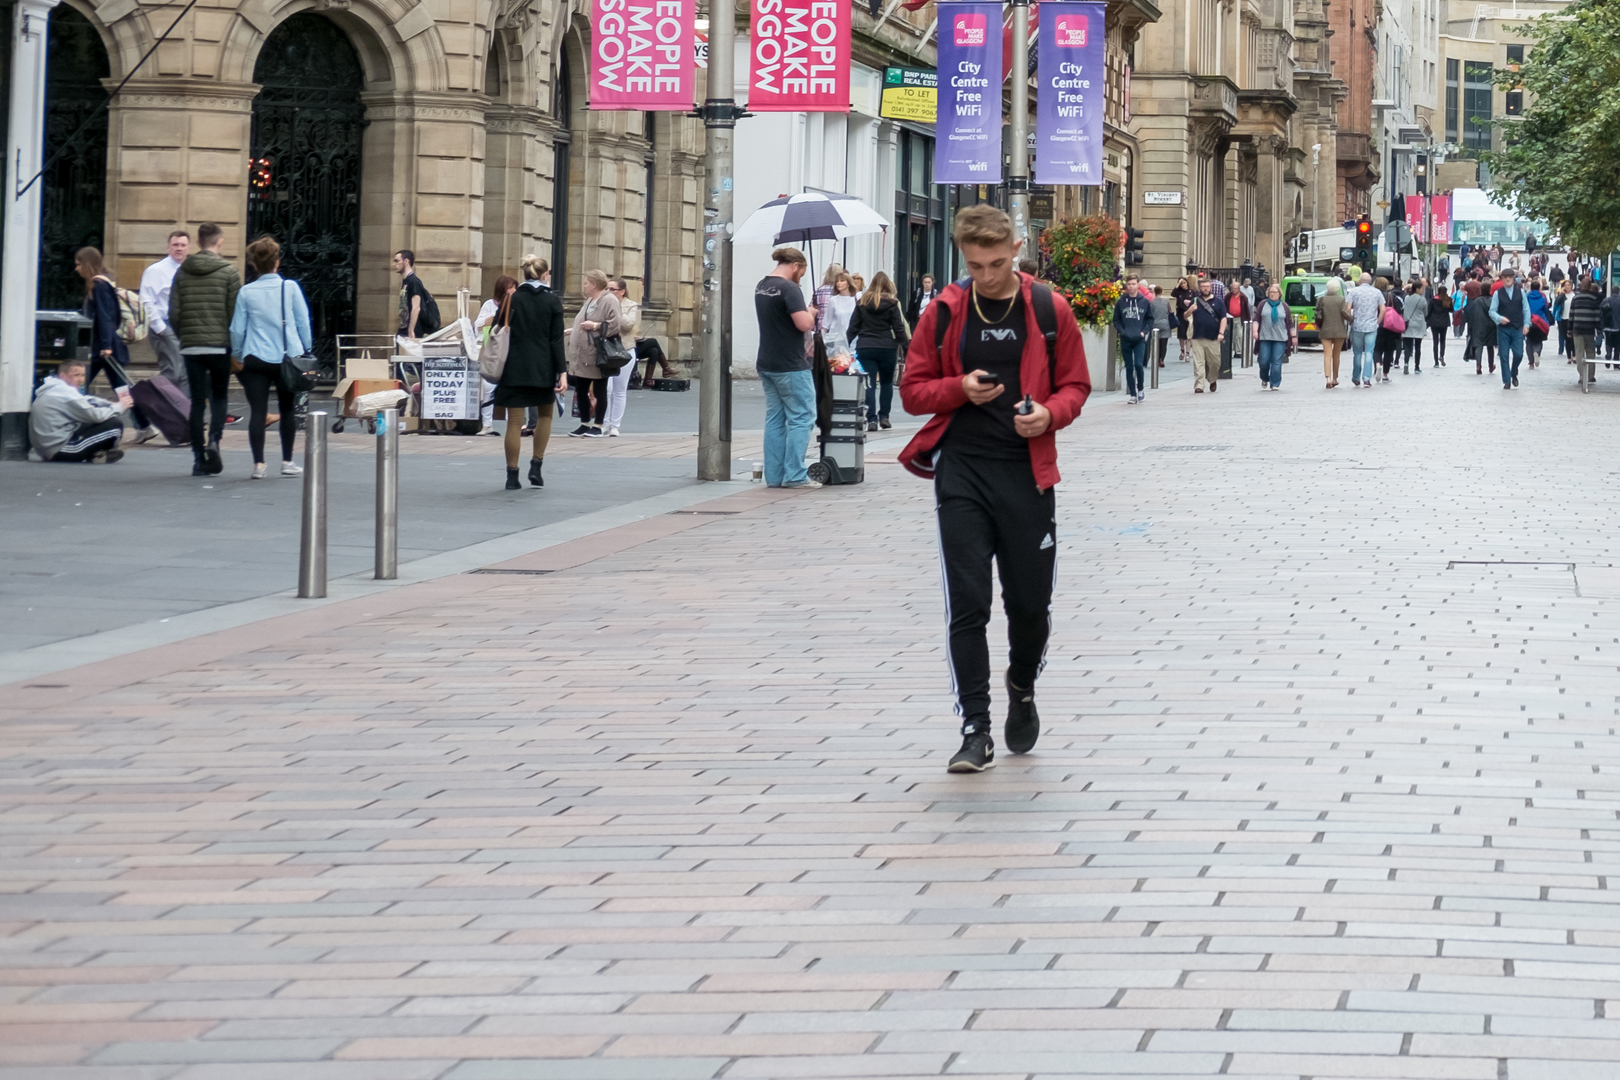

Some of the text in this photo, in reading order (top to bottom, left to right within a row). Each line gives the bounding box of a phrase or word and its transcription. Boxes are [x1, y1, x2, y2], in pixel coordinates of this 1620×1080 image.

[626, 6, 653, 93] MAKE
[782, 7, 809, 94] MAKE
[958, 61, 981, 75] City
[1059, 62, 1083, 76] City
[951, 76, 988, 87] Centre
[1052, 77, 1090, 88] Centre
[918, 90, 930, 98] LET
[956, 90, 982, 101] Free
[1058, 91, 1083, 103] Free
[955, 104, 982, 116] WiFi
[1057, 105, 1083, 117] WiFi
[969, 162, 988, 171] wifi
[1070, 163, 1088, 172] wifi
